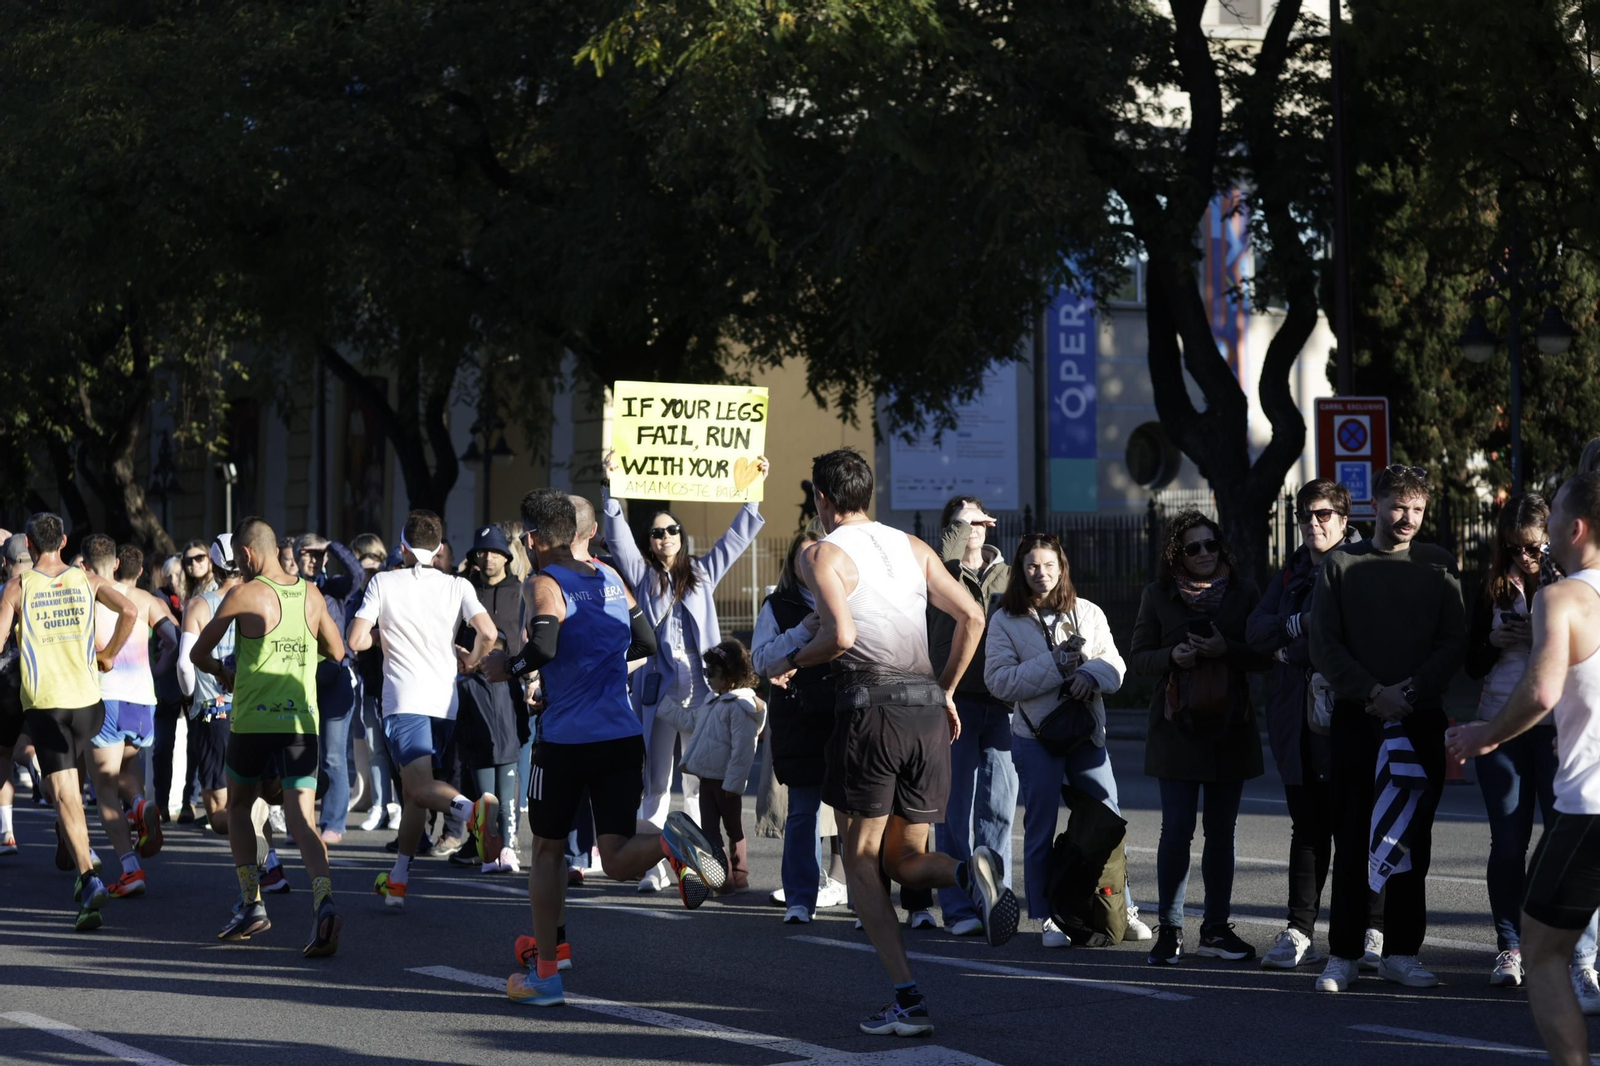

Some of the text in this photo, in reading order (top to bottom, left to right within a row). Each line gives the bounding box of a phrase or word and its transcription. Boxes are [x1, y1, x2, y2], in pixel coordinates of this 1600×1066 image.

[1055, 302, 1087, 419] ÓPER
[622, 397, 765, 422] IF YOUR LEGS
[1347, 403, 1383, 411] EXCLUSIVO
[706, 426, 750, 449] RUN
[621, 456, 729, 478] WITH YOUR
[33, 591, 52, 600] JUNTA
[30, 599, 62, 609] CARNAXIDE
[35, 607, 85, 621] J.J. FRUTAS
[43, 617, 80, 630] QUEIJAS
